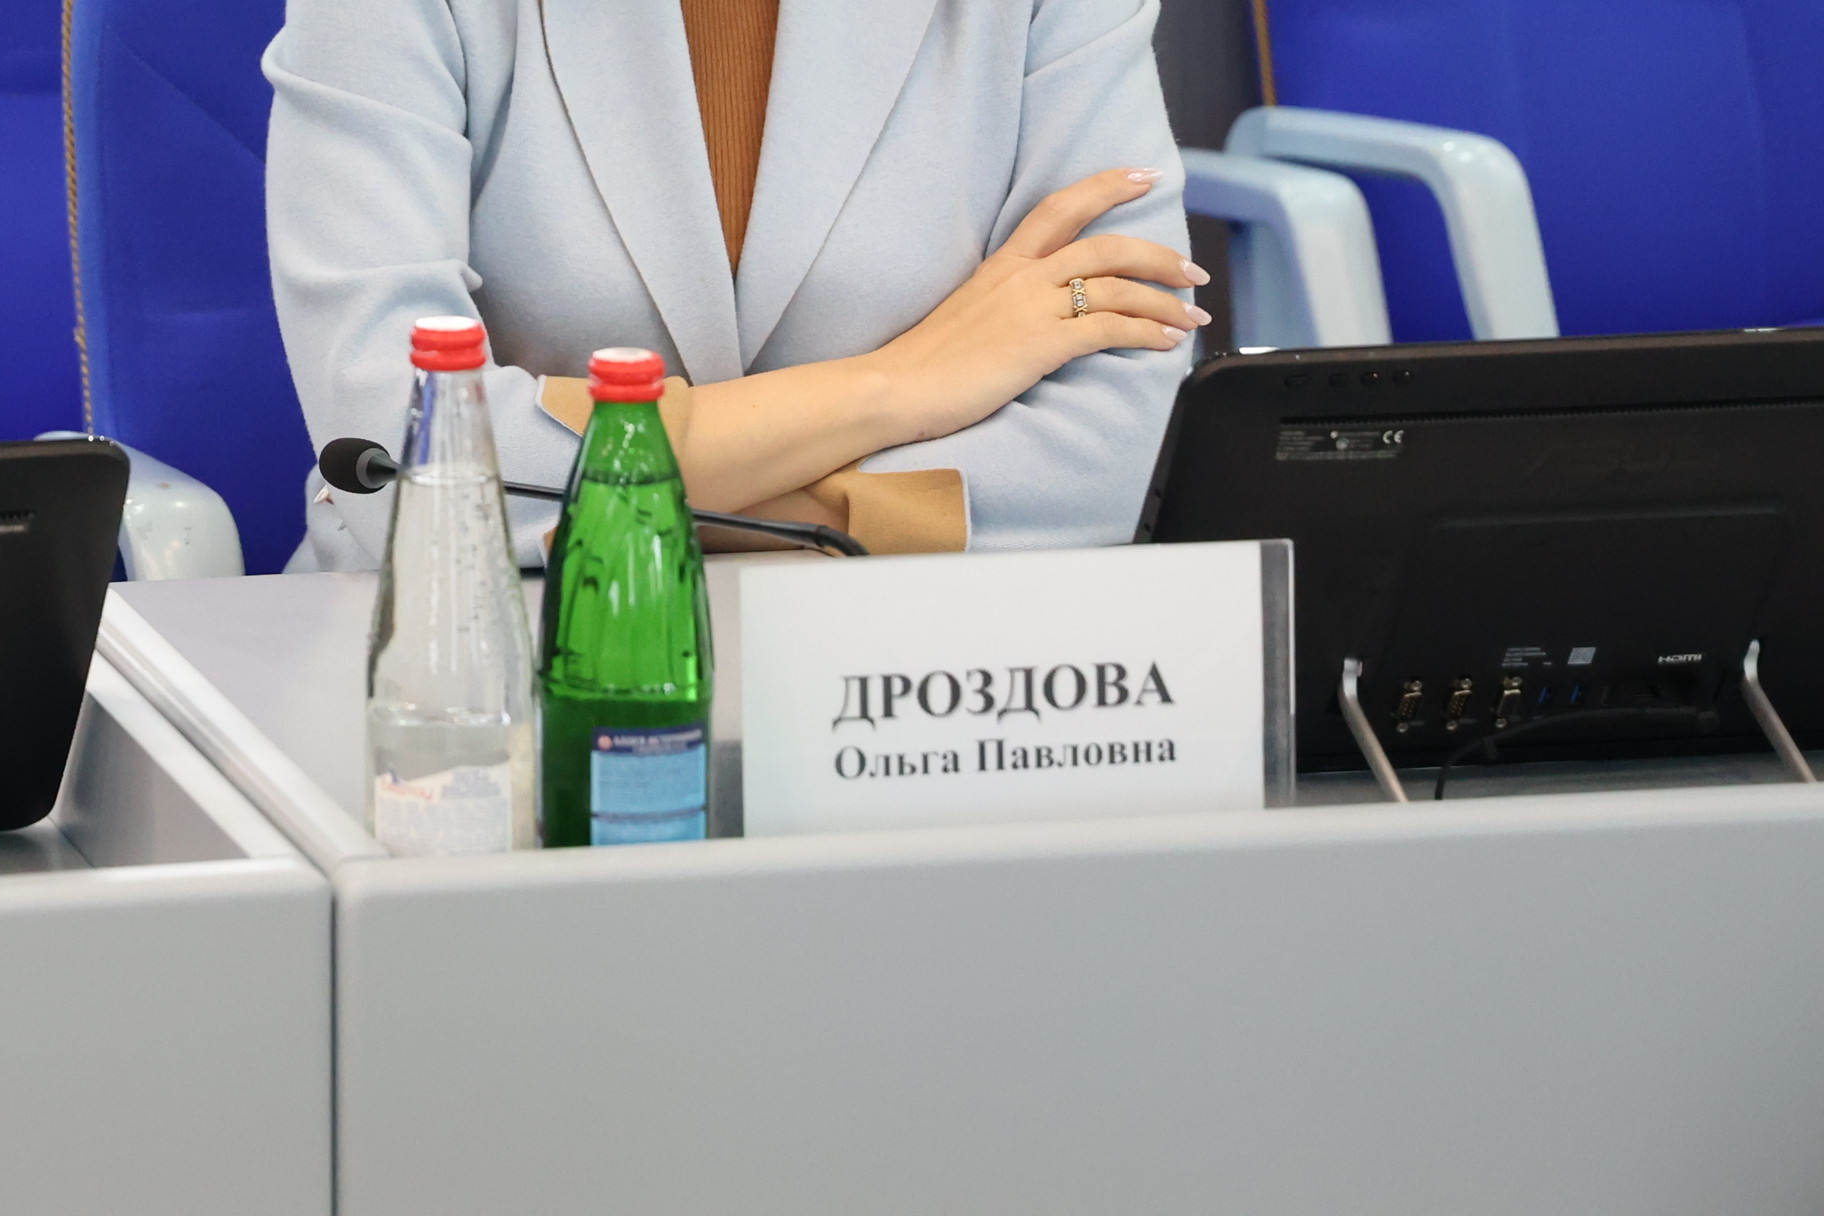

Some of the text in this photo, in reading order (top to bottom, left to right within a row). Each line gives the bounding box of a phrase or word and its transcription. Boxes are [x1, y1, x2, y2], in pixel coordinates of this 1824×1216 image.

[832, 661, 1175, 730] ДРОЗДОВА
[833, 738, 1179, 781] Ольга Павловна
